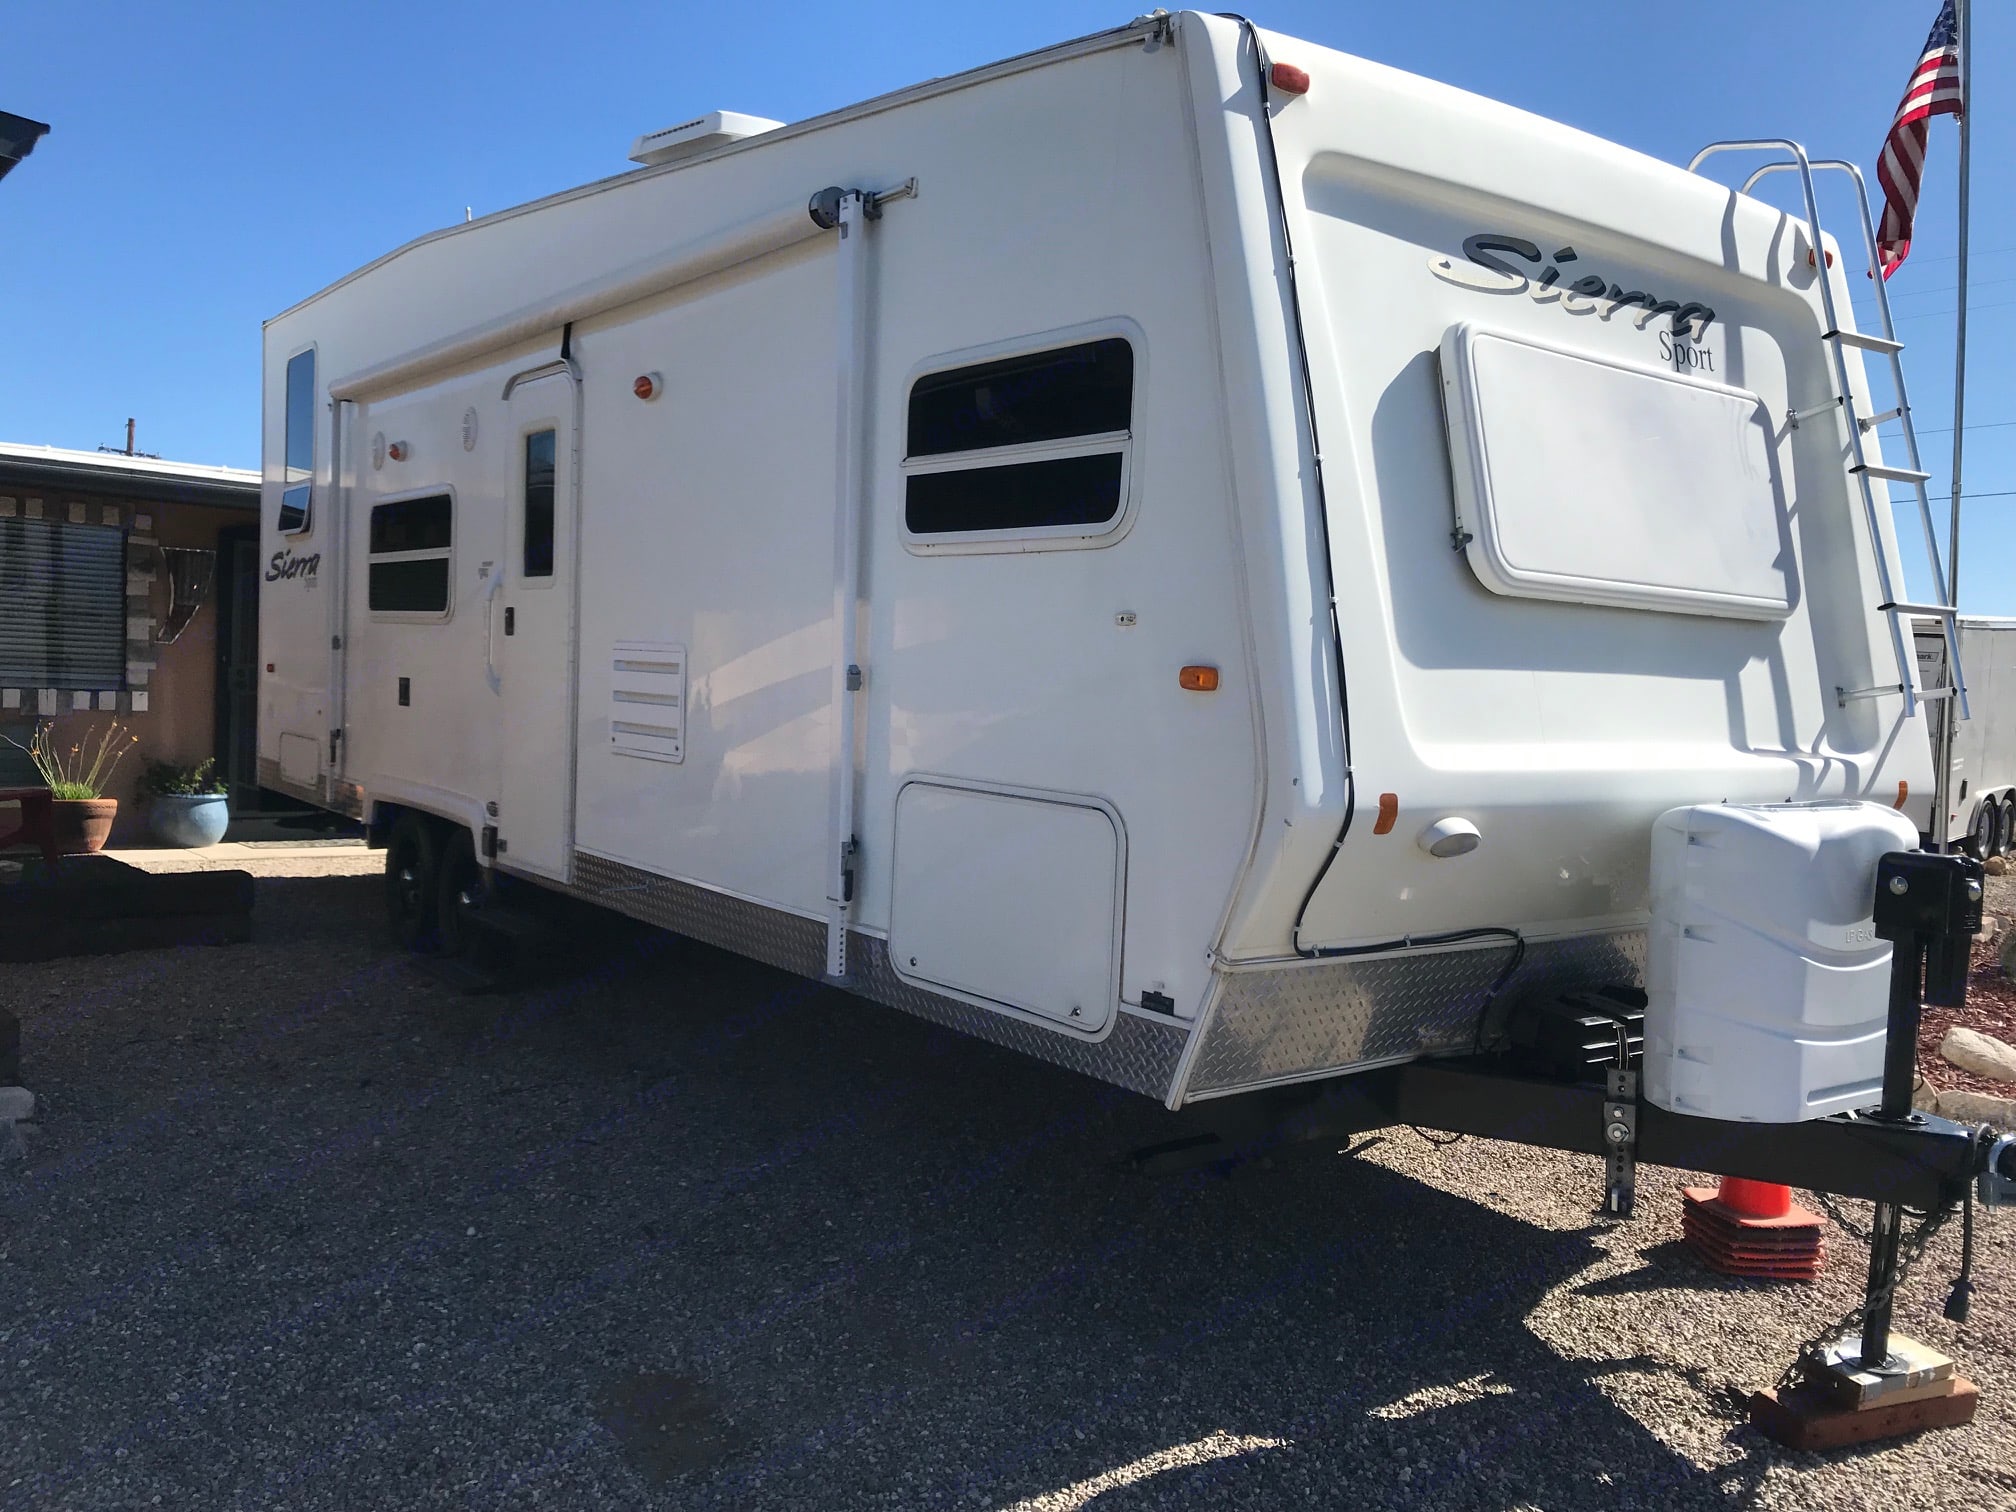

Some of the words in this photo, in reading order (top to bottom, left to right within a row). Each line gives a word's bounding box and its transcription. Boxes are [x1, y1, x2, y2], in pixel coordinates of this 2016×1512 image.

[1427, 234, 1715, 344] Sierra
[1659, 330, 1715, 373] Sport
[265, 548, 320, 582] Sierra
